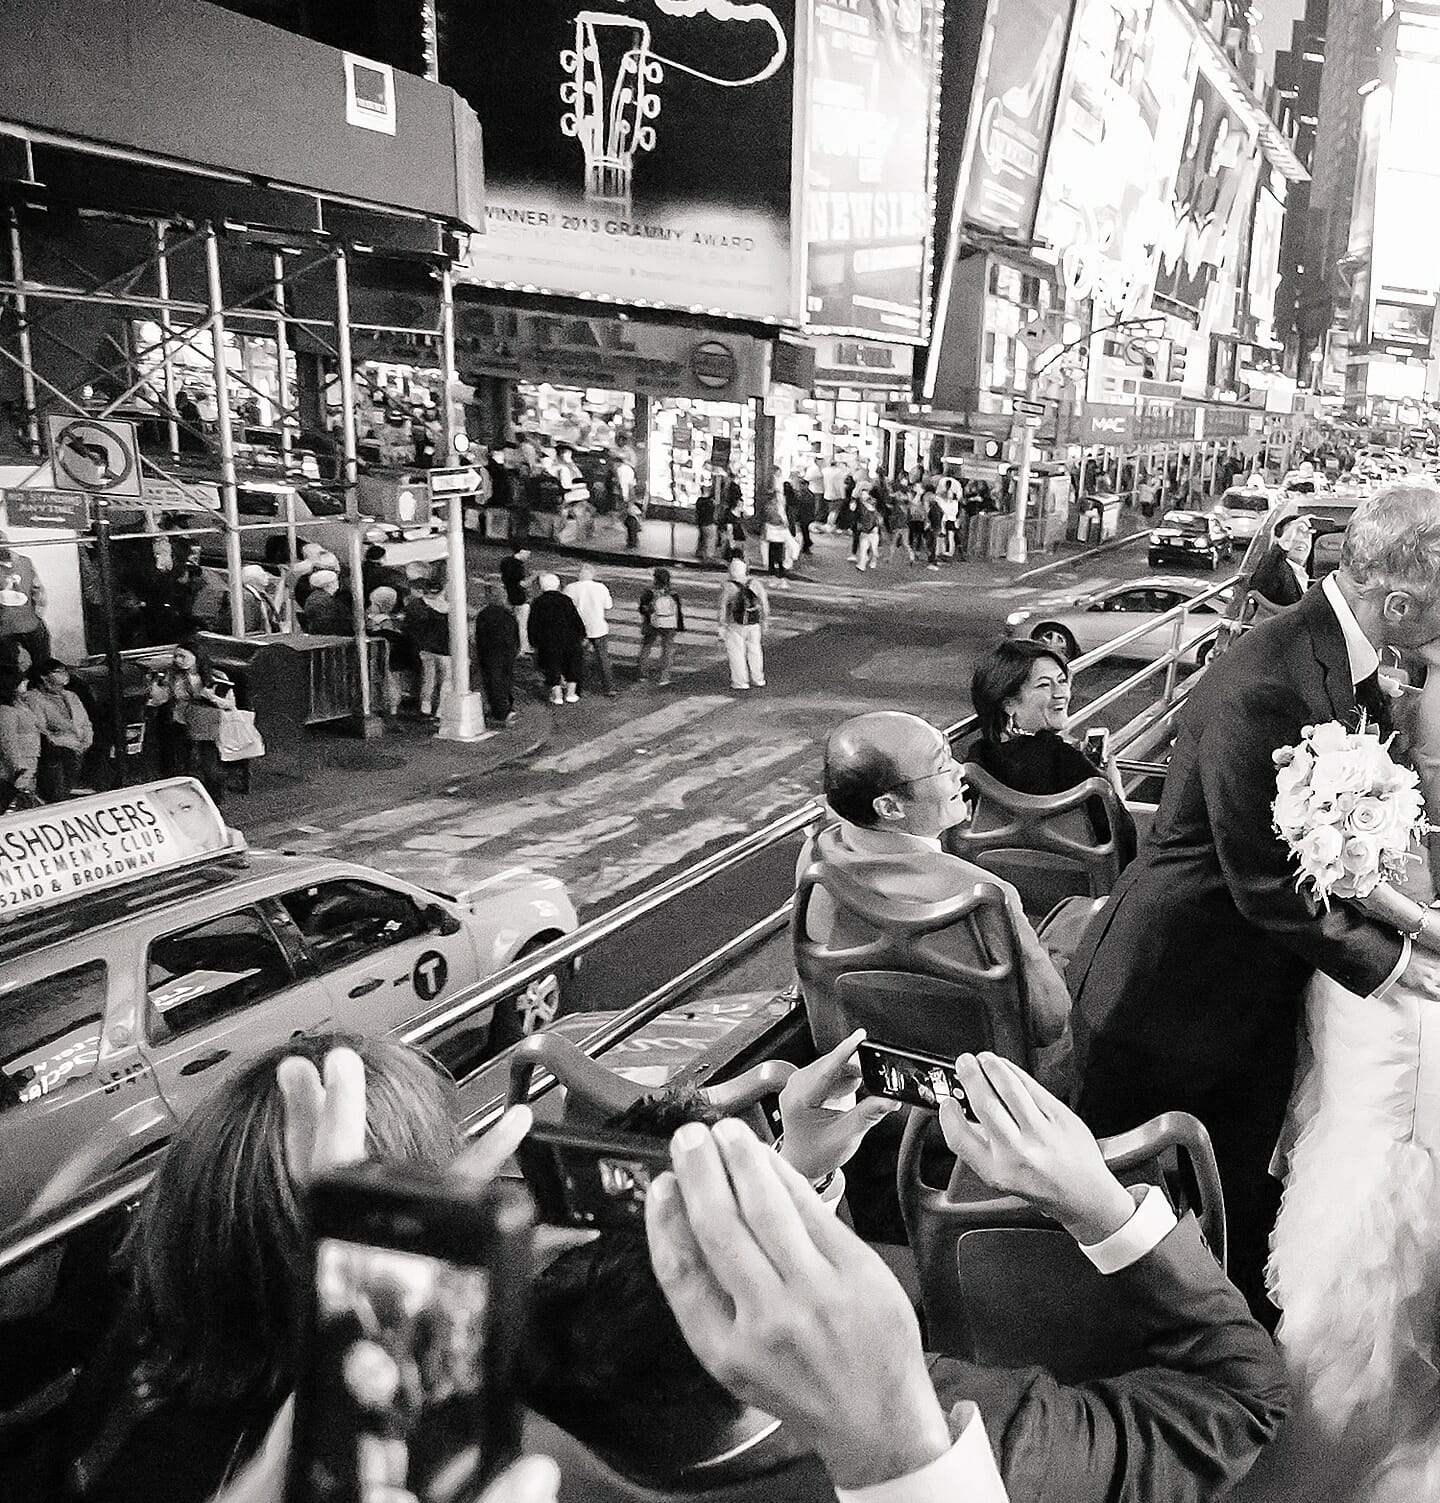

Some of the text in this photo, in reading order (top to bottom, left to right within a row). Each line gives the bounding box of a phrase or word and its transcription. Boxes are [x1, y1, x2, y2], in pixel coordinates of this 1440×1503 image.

[561, 214, 600, 233] 2013
[604, 219, 684, 241] GRAMMY
[691, 230, 754, 252] AWARD
[120, 828, 165, 851] CLUB
[51, 879, 62, 892] &
[72, 851, 157, 887] BROADWAY
[418, 957, 441, 994] T
